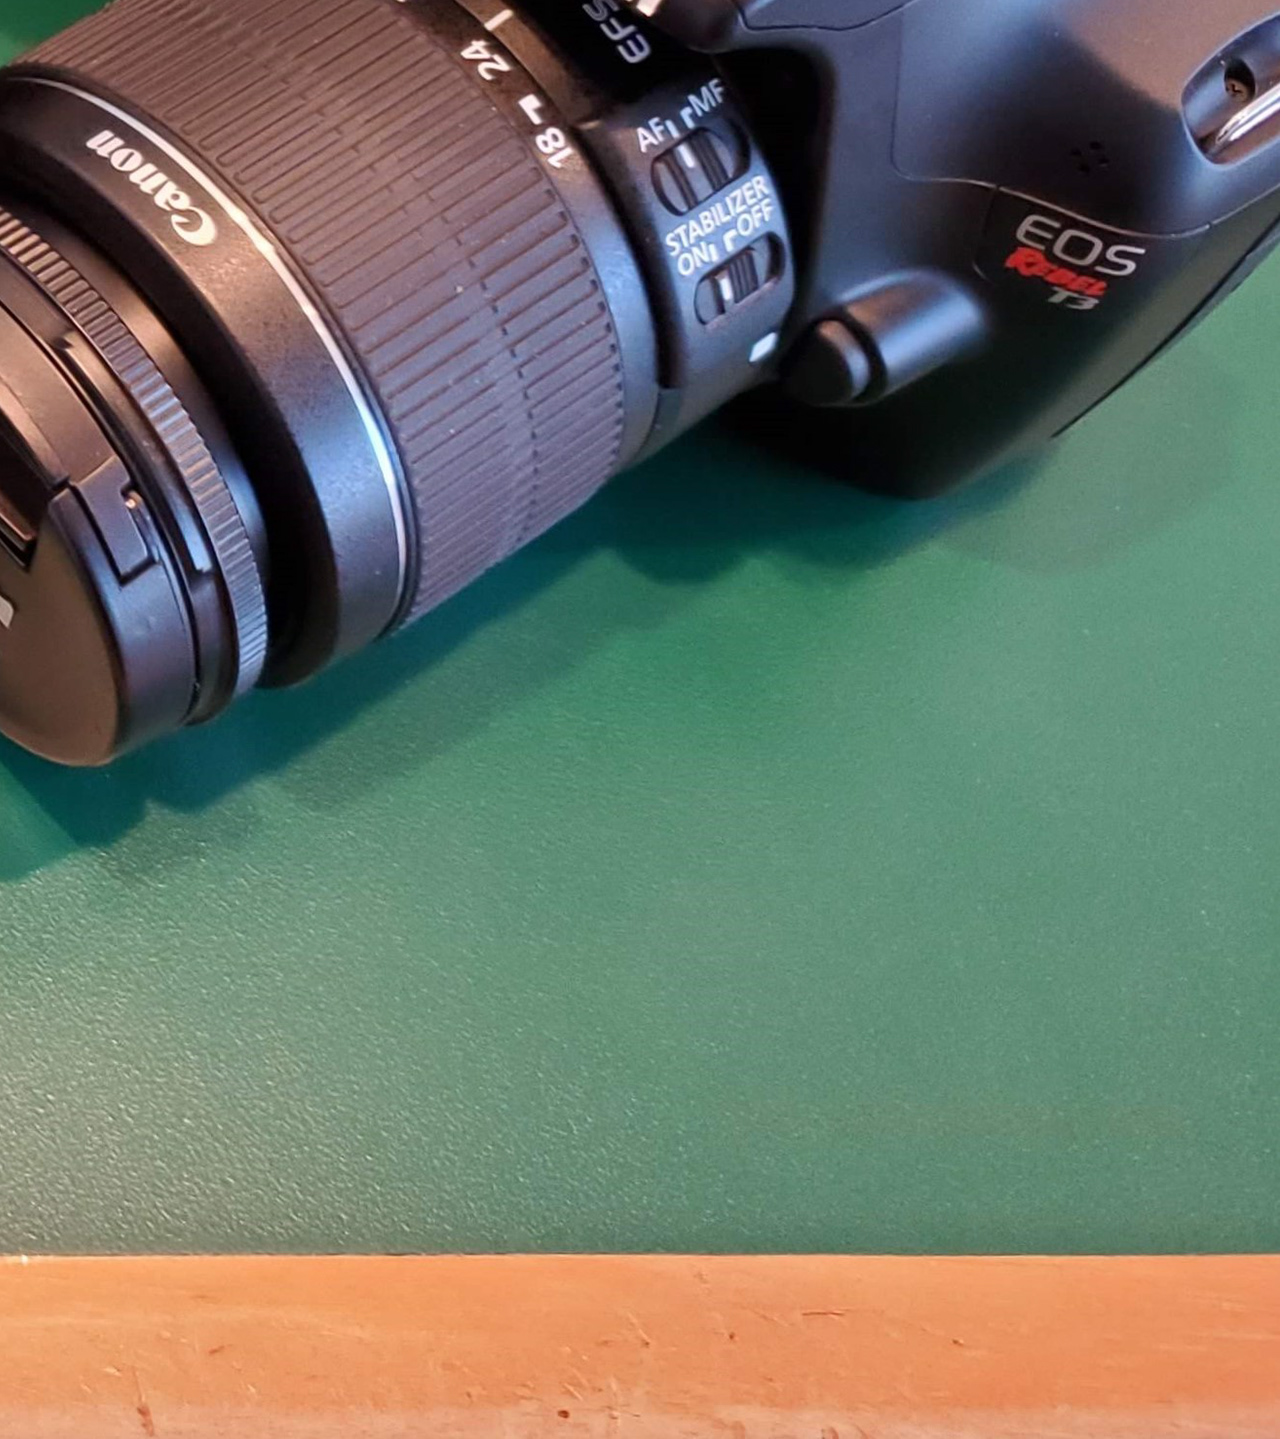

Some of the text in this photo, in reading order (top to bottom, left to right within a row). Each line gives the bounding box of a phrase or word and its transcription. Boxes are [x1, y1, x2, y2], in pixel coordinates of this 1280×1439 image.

[460, 38, 513, 81] 24
[534, 126, 575, 169] 18
[636, 78, 725, 153] AF MF
[85, 129, 218, 247] Canon
[665, 175, 771, 256] STABILIZER
[677, 198, 775, 276] ON OFF
[1016, 214, 1146, 277] EOS
[1048, 286, 1100, 310] T3
